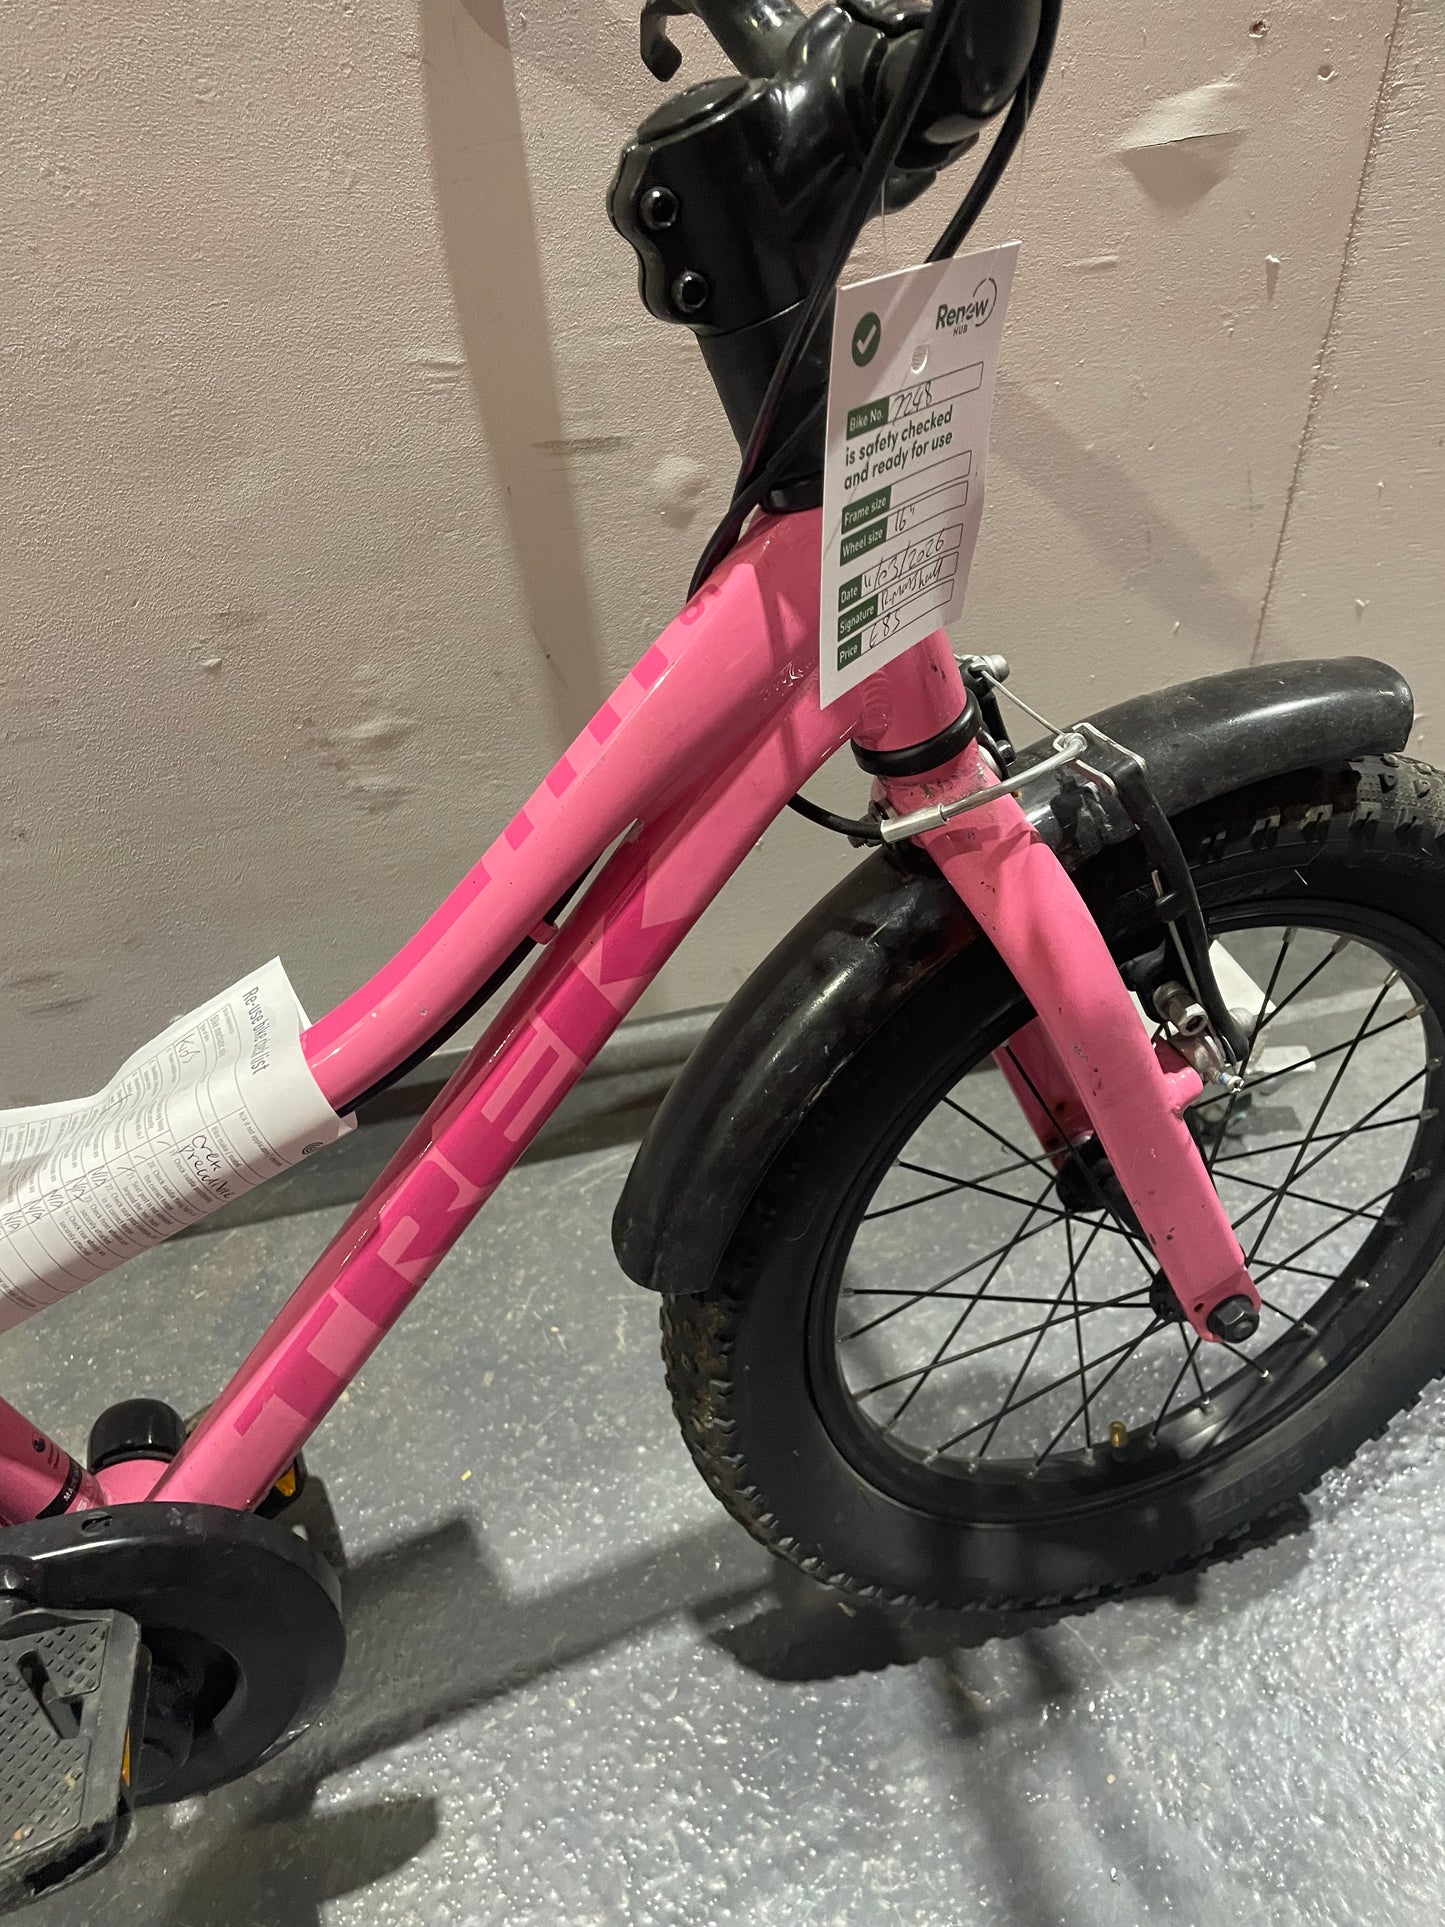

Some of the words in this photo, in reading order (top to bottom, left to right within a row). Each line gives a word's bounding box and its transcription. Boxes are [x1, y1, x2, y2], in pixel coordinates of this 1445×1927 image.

[936, 298, 990, 330] Renew
[953, 324, 968, 337] HUB
[849, 413, 868, 433] Bike
[870, 408, 884, 425] No.
[845, 446, 856, 466] is
[859, 431, 899, 462] safety
[901, 405, 953, 440] checked
[844, 465, 869, 490] and
[872, 448, 909, 478] ready
[911, 439, 929, 460] for
[931, 431, 953, 451] use
[844, 504, 870, 527] Frame
[871, 496, 887, 513] size
[842, 538, 867, 558] Wheel
[868, 528, 884, 545] size
[841, 586, 858, 604] Date
[840, 605, 875, 634] Signature
[839, 644, 858, 664] Price
[242, 986, 265, 1025] Re-use
[252, 1017, 268, 1042] bike
[250, 1051, 270, 1075] list
[234, 855, 697, 1437] TREK
[68, 1214, 82, 1230] Check
